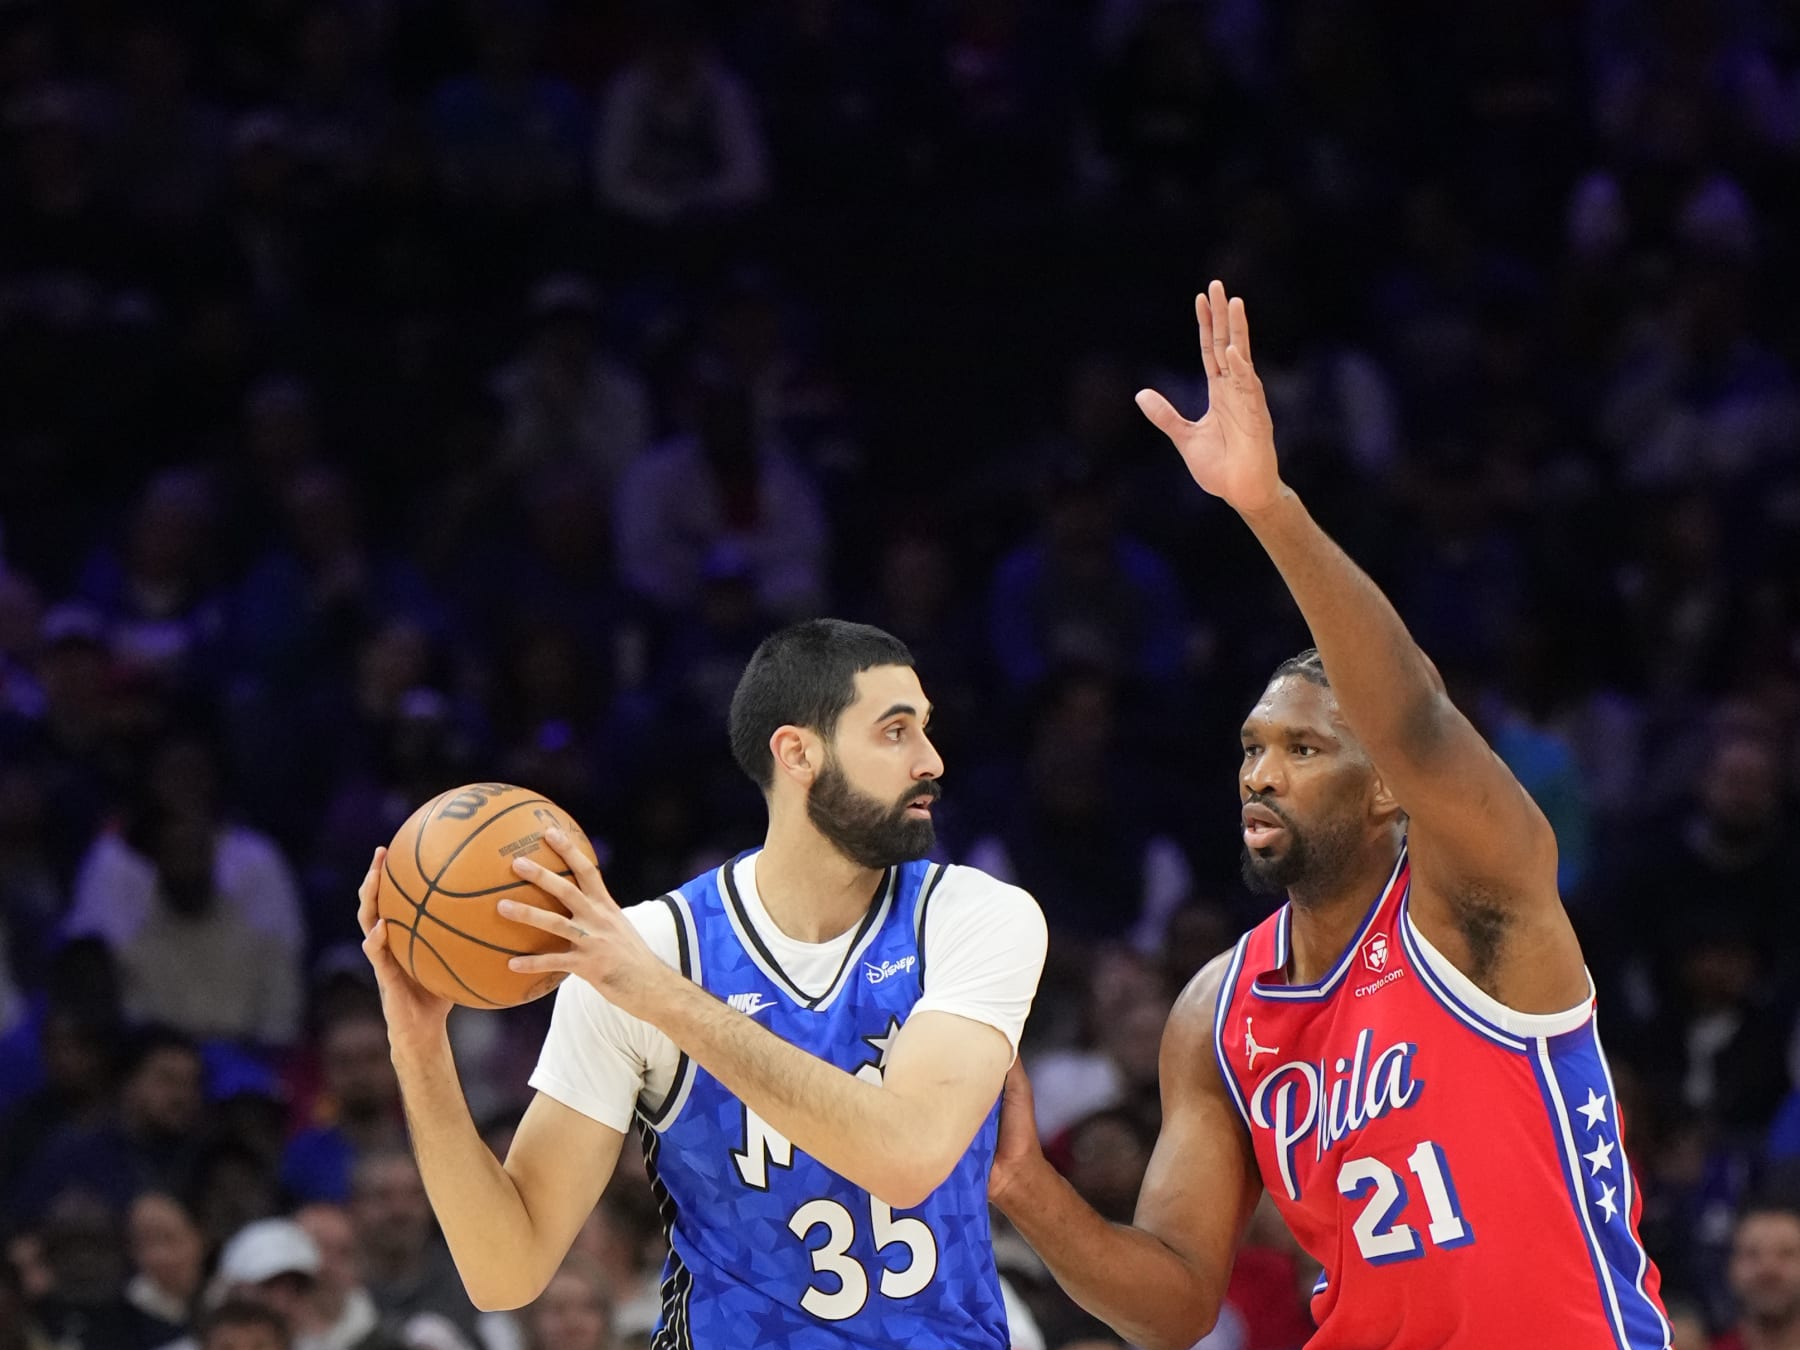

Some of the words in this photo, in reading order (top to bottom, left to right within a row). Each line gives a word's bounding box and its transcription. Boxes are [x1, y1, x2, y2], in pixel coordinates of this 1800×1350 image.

[727, 992, 763, 1014] NIKE
[864, 955, 916, 984] Disney
[1355, 968, 1404, 998] crypto.com
[1250, 1028, 1424, 1200] Phila
[1337, 1140, 1475, 1265] 21
[787, 1194, 938, 1321] 35
